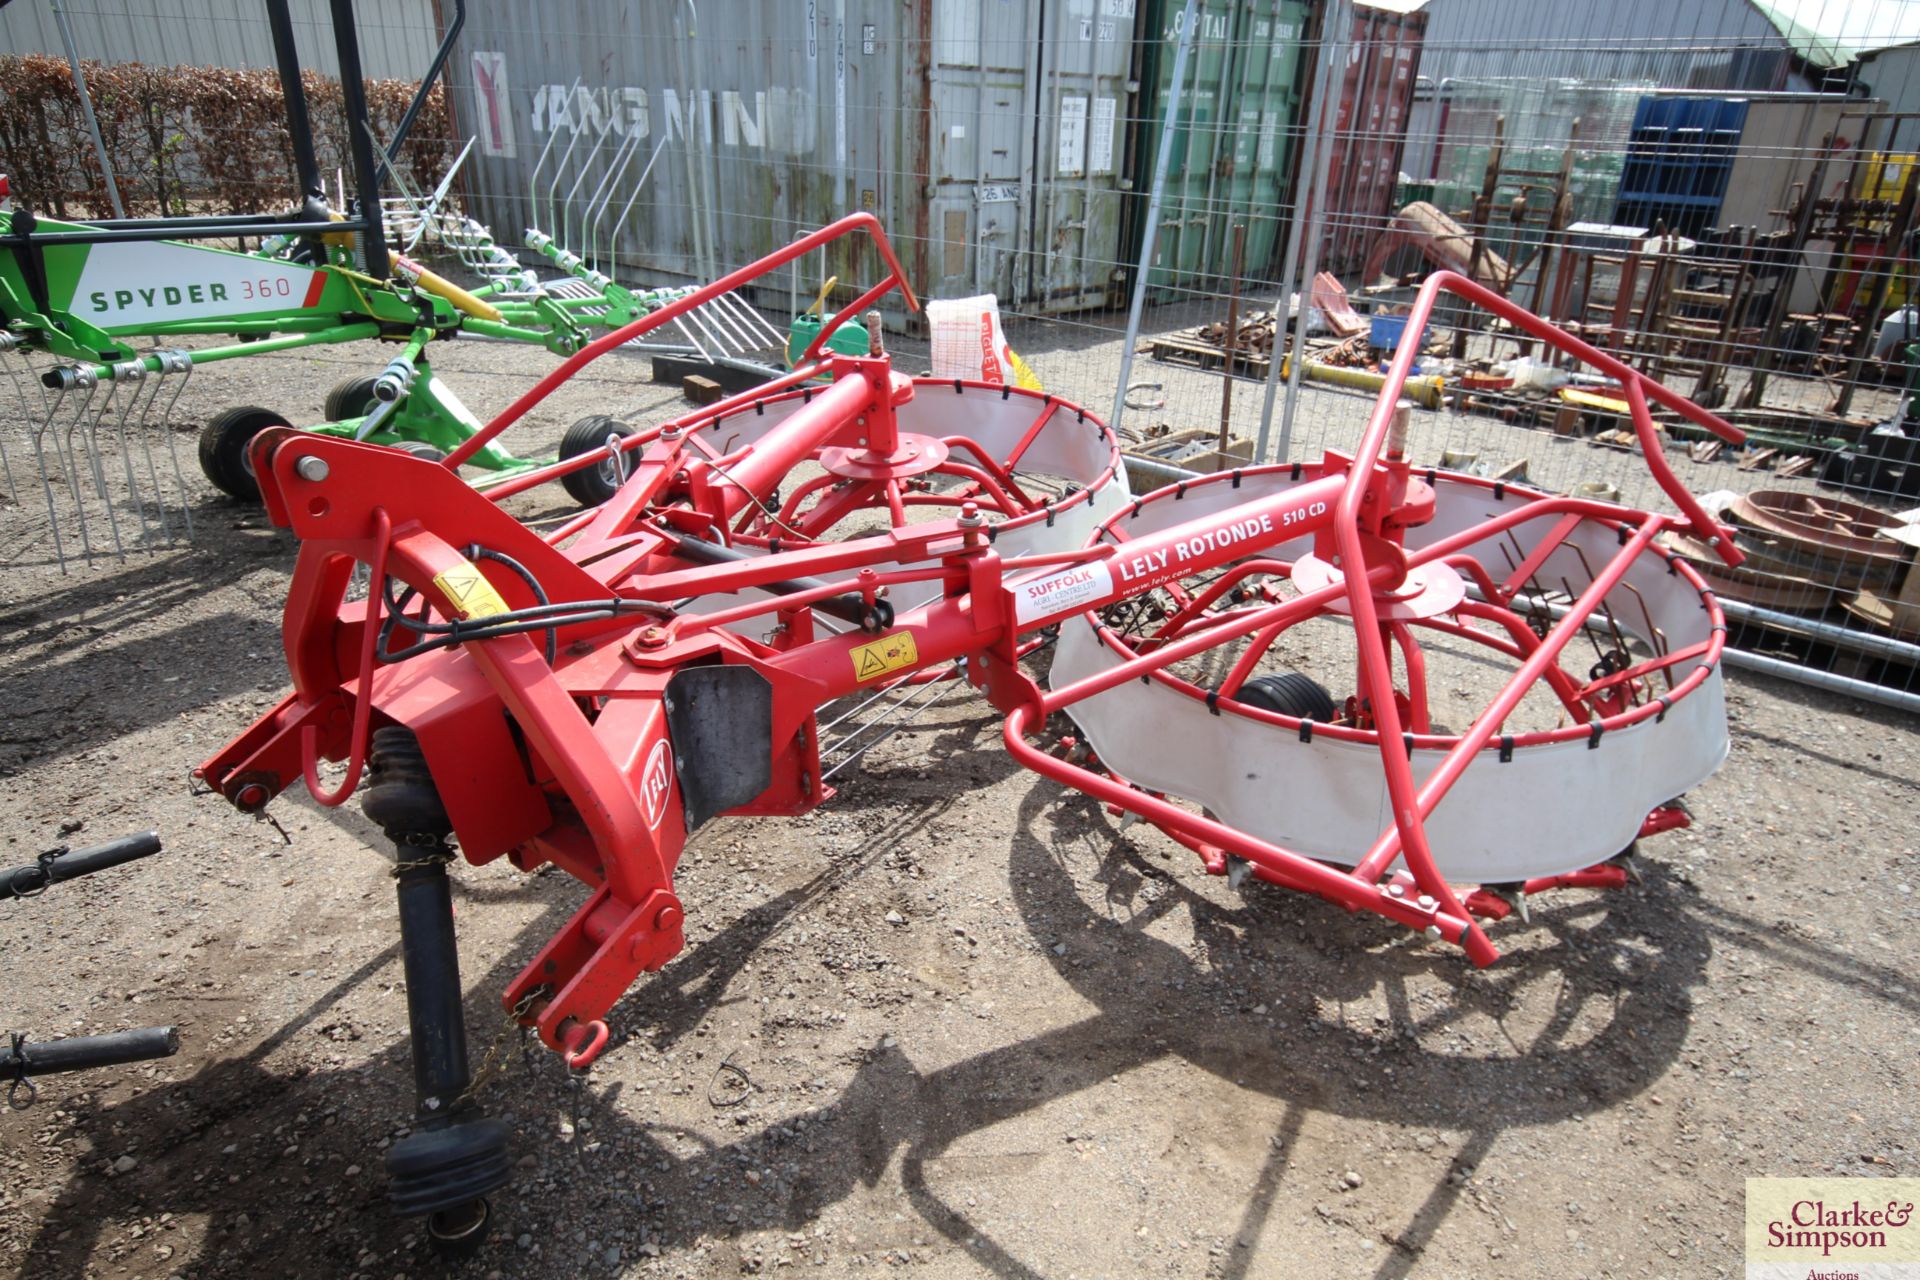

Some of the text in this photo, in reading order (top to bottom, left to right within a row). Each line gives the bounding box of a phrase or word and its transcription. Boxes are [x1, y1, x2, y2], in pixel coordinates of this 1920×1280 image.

[1174, 10, 1228, 39] CPTAL
[531, 84, 650, 138] YANG
[90, 278, 290, 312] SPYDER 360
[981, 322, 997, 374] PIGLET
[1119, 501, 1326, 582] LELY ROTONDE 510 CD
[1028, 570, 1093, 598] SUFFOLK
[1122, 567, 1193, 596] www.lely.com
[644, 743, 668, 824] LELY
